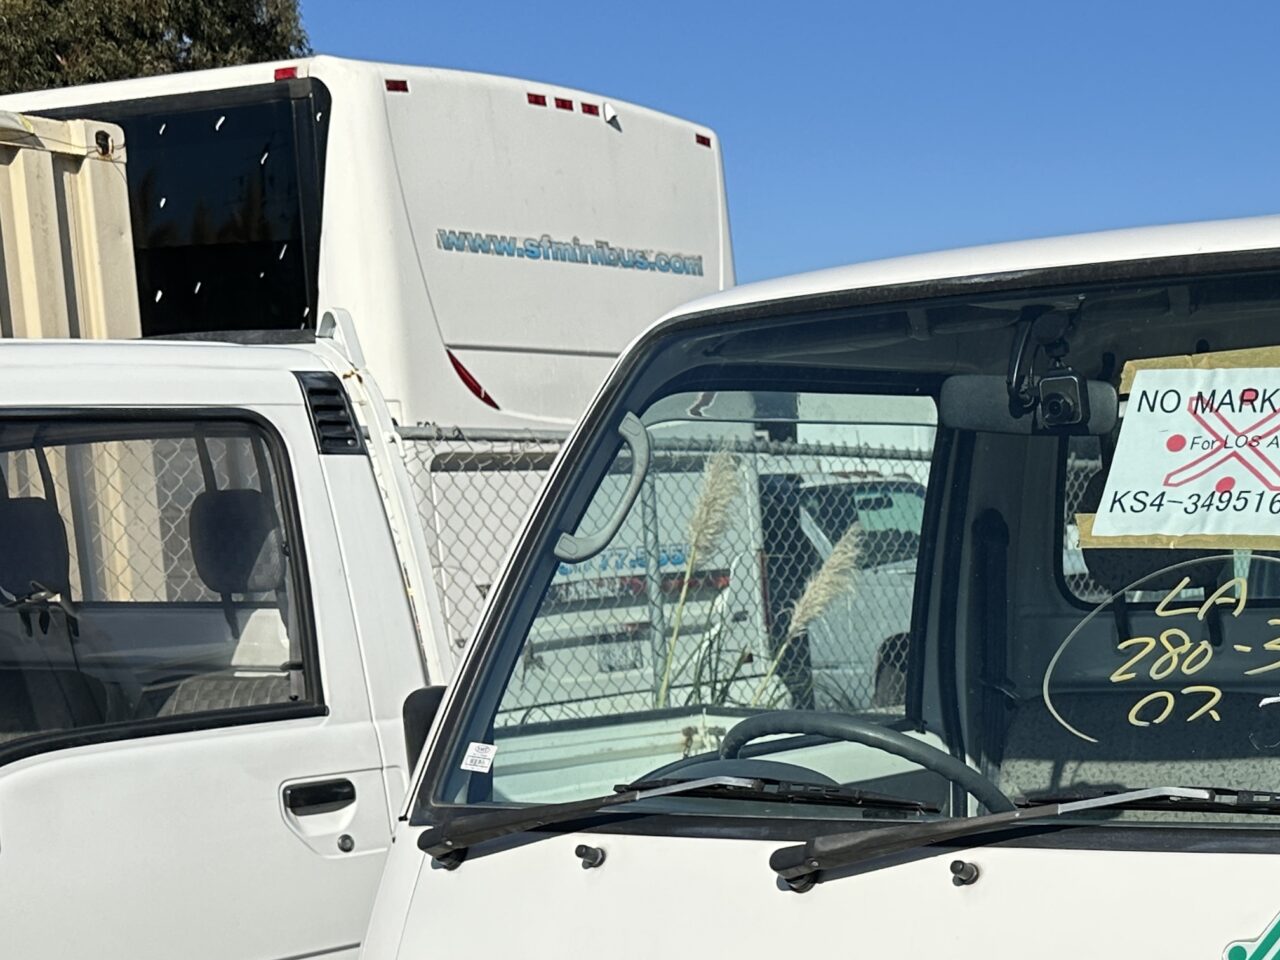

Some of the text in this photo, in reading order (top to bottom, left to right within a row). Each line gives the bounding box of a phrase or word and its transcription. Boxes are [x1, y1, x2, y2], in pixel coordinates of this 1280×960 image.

[436, 228, 704, 277] www.sfminibus.com
[1137, 388, 1280, 414] NO MARK
[1190, 435, 1221, 451] For
[1223, 433, 1261, 449] LOS
[1155, 576, 1248, 620] LA
